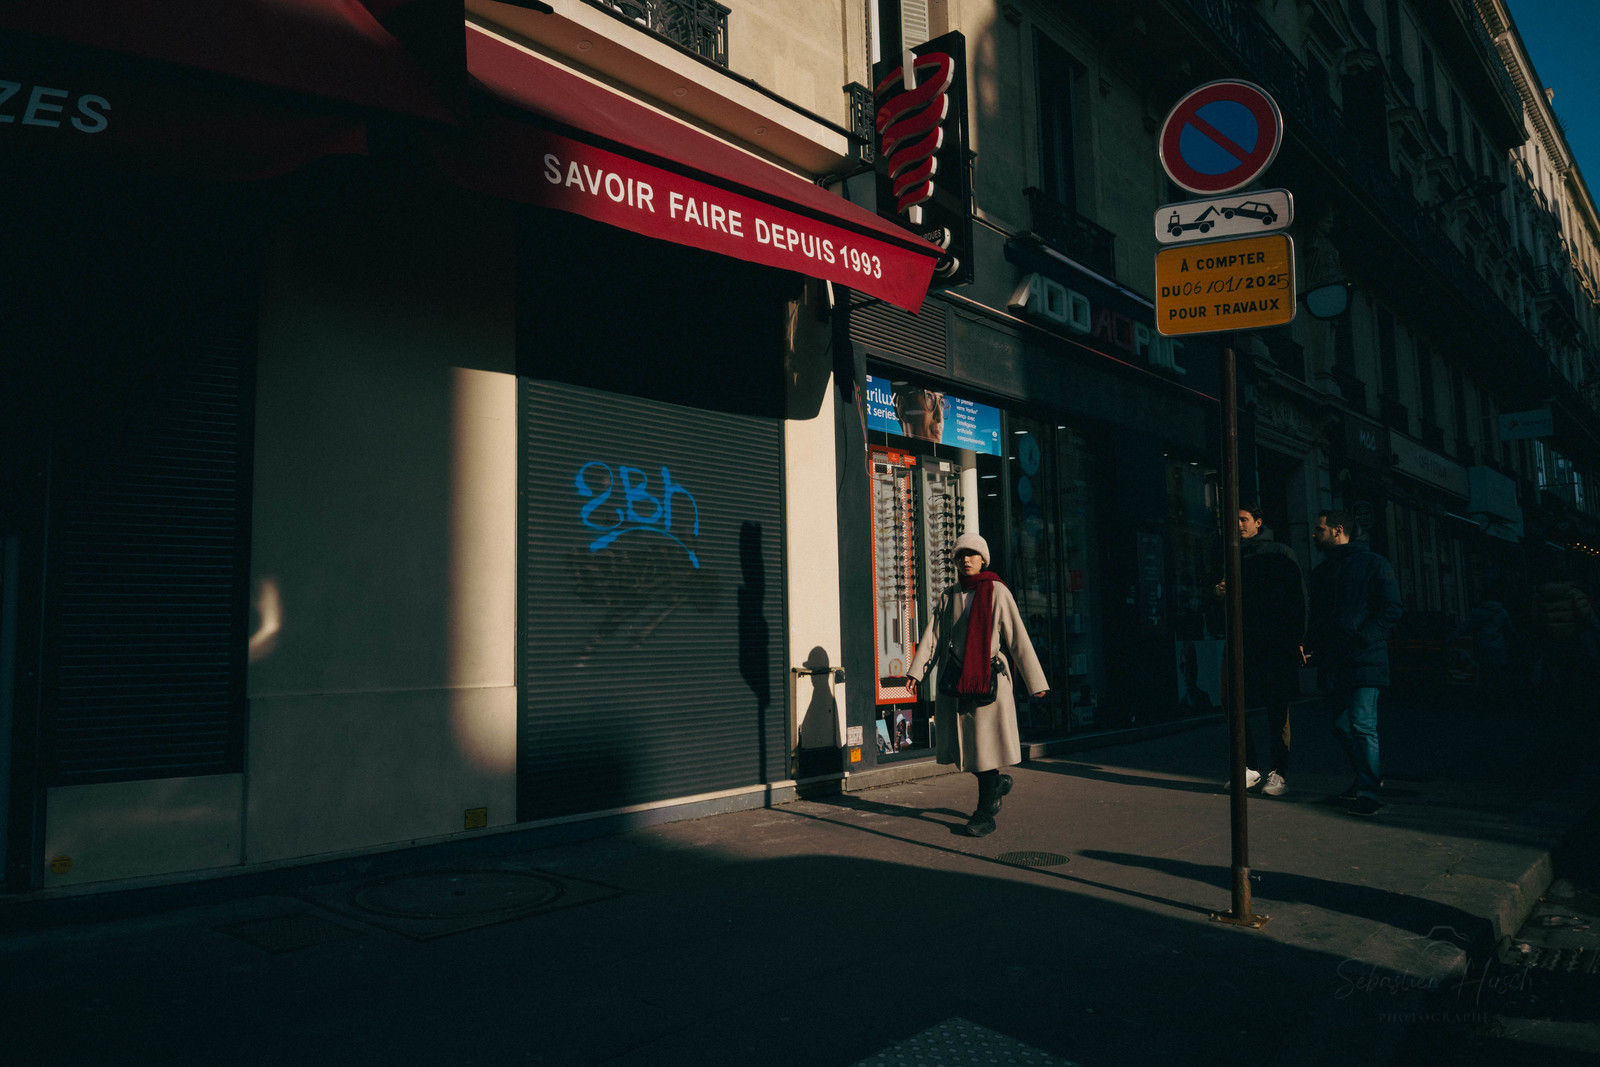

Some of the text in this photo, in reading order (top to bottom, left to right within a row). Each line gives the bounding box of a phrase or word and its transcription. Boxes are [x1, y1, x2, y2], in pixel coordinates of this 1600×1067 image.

[543, 153, 882, 279] SAVOIR FAIRE DEPUIS 1993
[1196, 252, 1265, 270] COMPTER
[1169, 298, 1280, 320] POUR TRAVAUX
